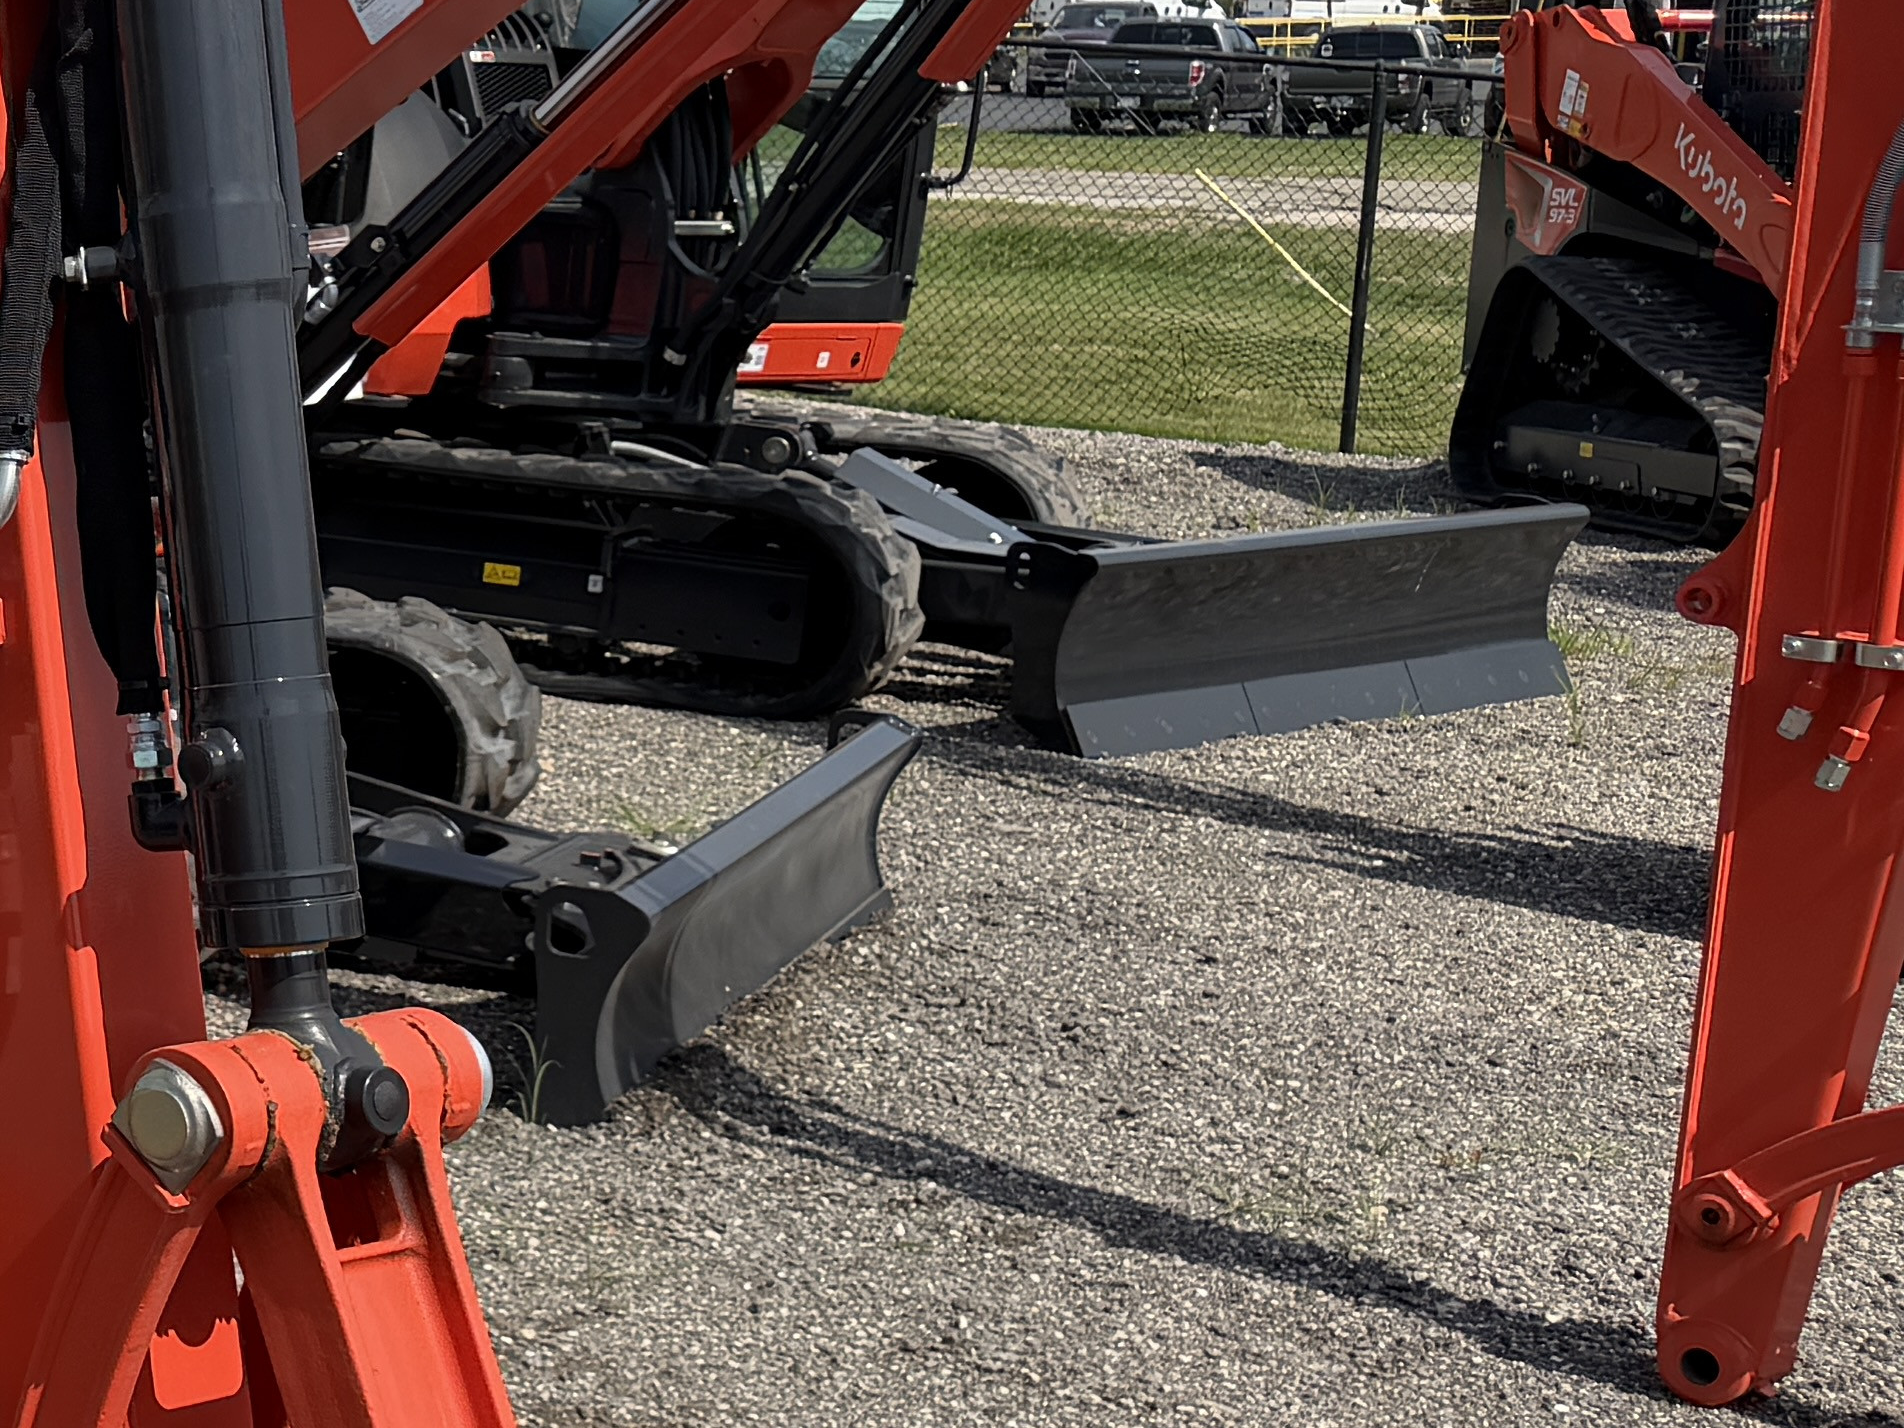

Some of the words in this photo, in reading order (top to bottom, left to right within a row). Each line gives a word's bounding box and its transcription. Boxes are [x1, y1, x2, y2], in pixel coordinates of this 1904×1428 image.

[1675, 122, 1746, 230] Kubota
[1550, 188, 1579, 207] SVL
[1548, 208, 1576, 224] 97-3
